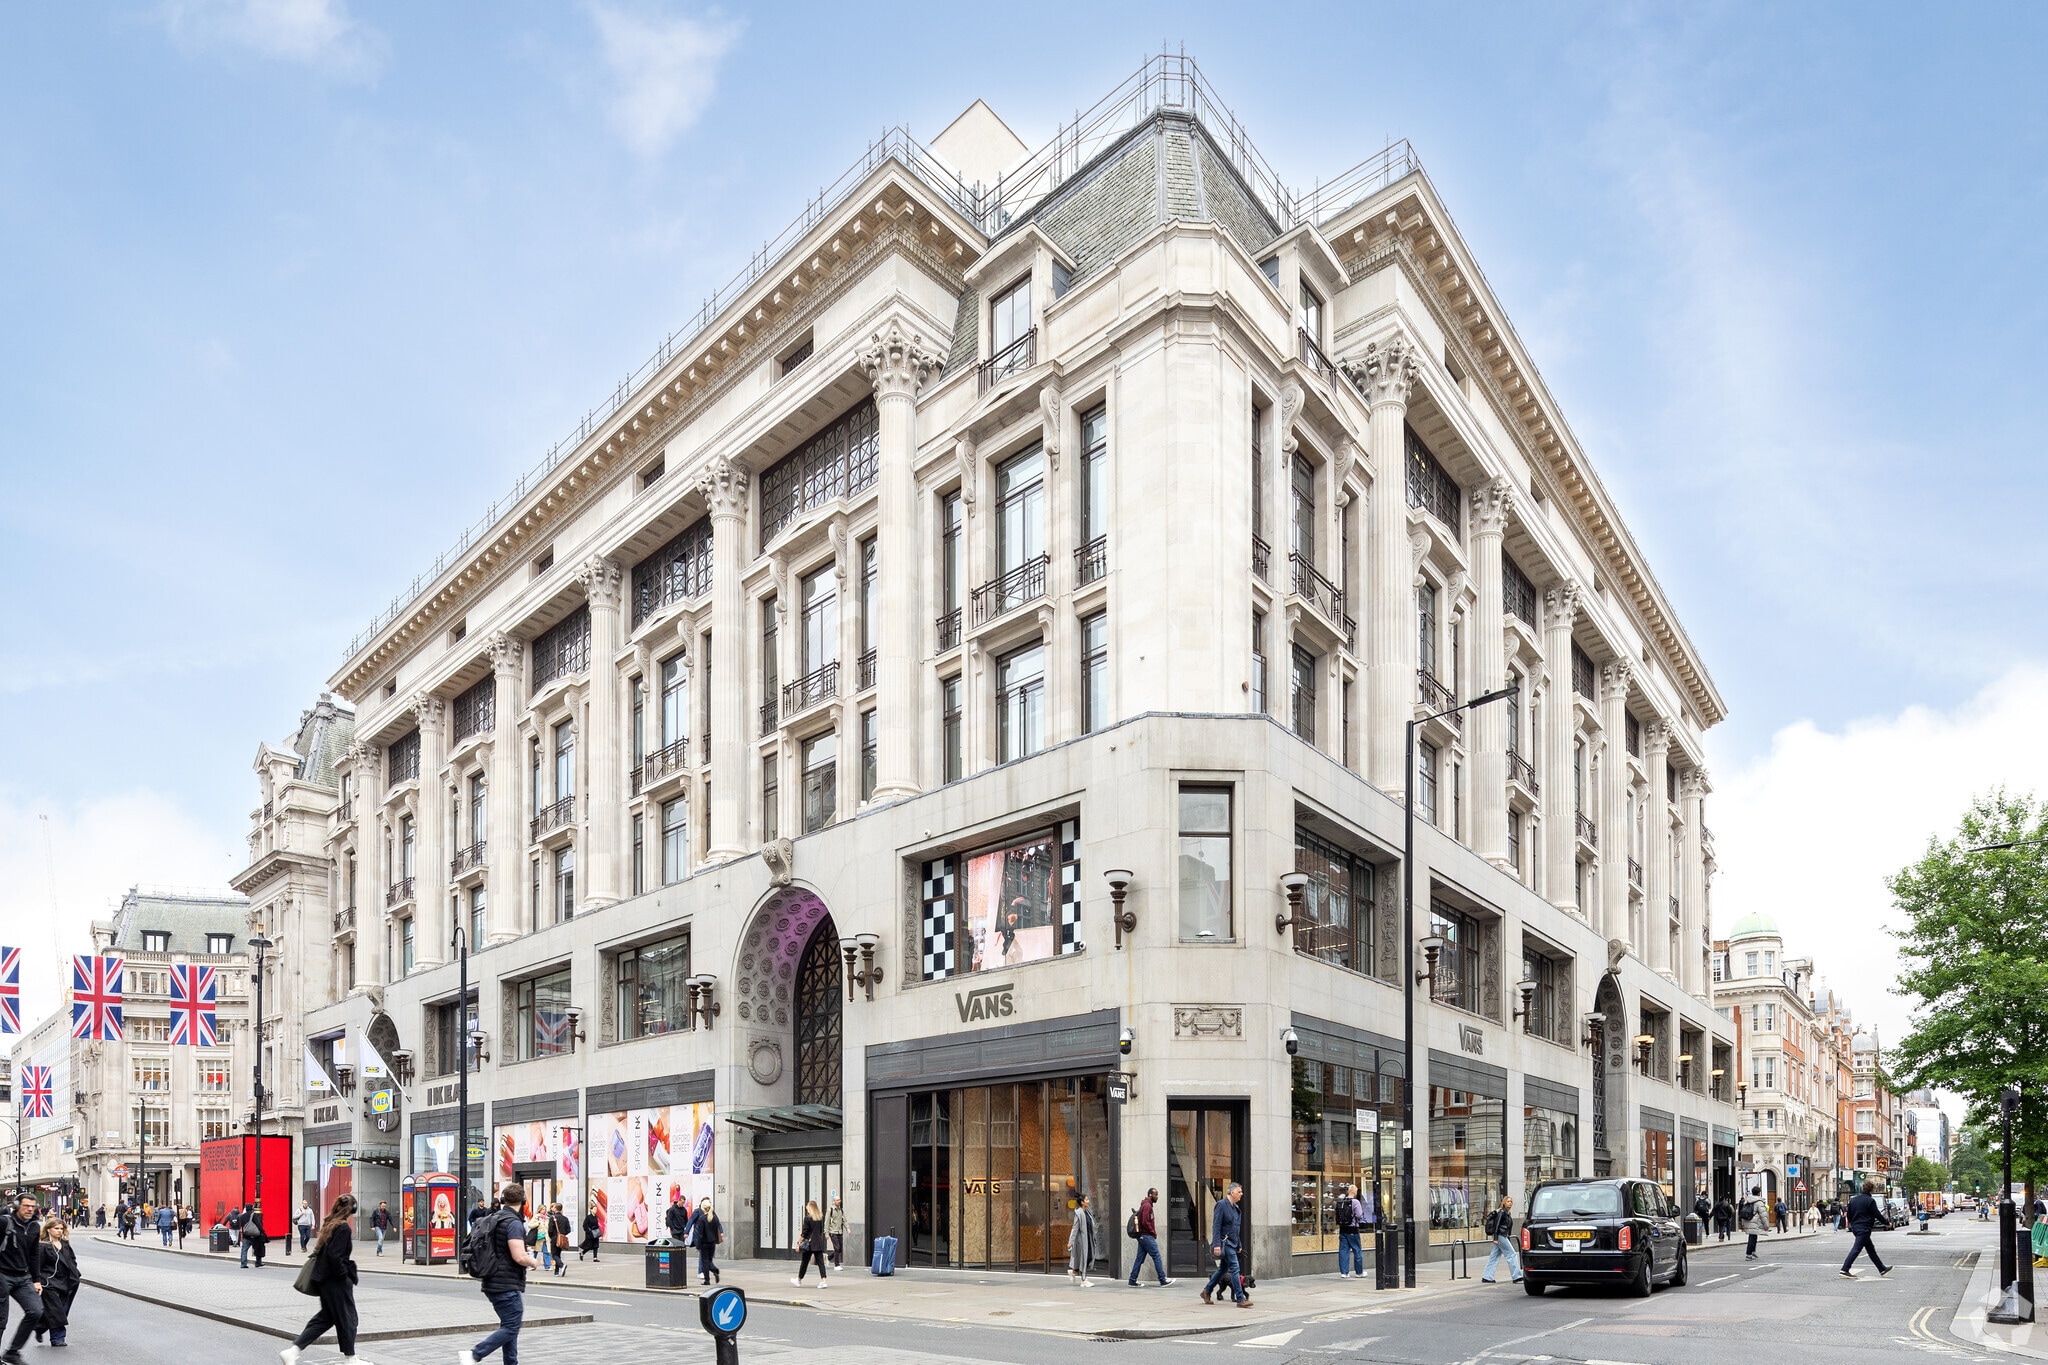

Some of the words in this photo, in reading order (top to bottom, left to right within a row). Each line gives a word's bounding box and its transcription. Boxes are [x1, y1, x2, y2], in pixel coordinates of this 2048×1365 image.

[955, 983, 1014, 1022] VANS
[1459, 1023, 1483, 1055] VANS
[1109, 1086, 1125, 1099] VANS
[374, 1097, 388, 1106] IKEA
[313, 1105, 339, 1124] IKEA
[673, 1134, 690, 1143] OXFORD
[225, 1144, 241, 1156] SECOND
[673, 1143, 690, 1152] STREET
[718, 1185, 726, 1194] 216
[850, 1181, 860, 1191] 216
